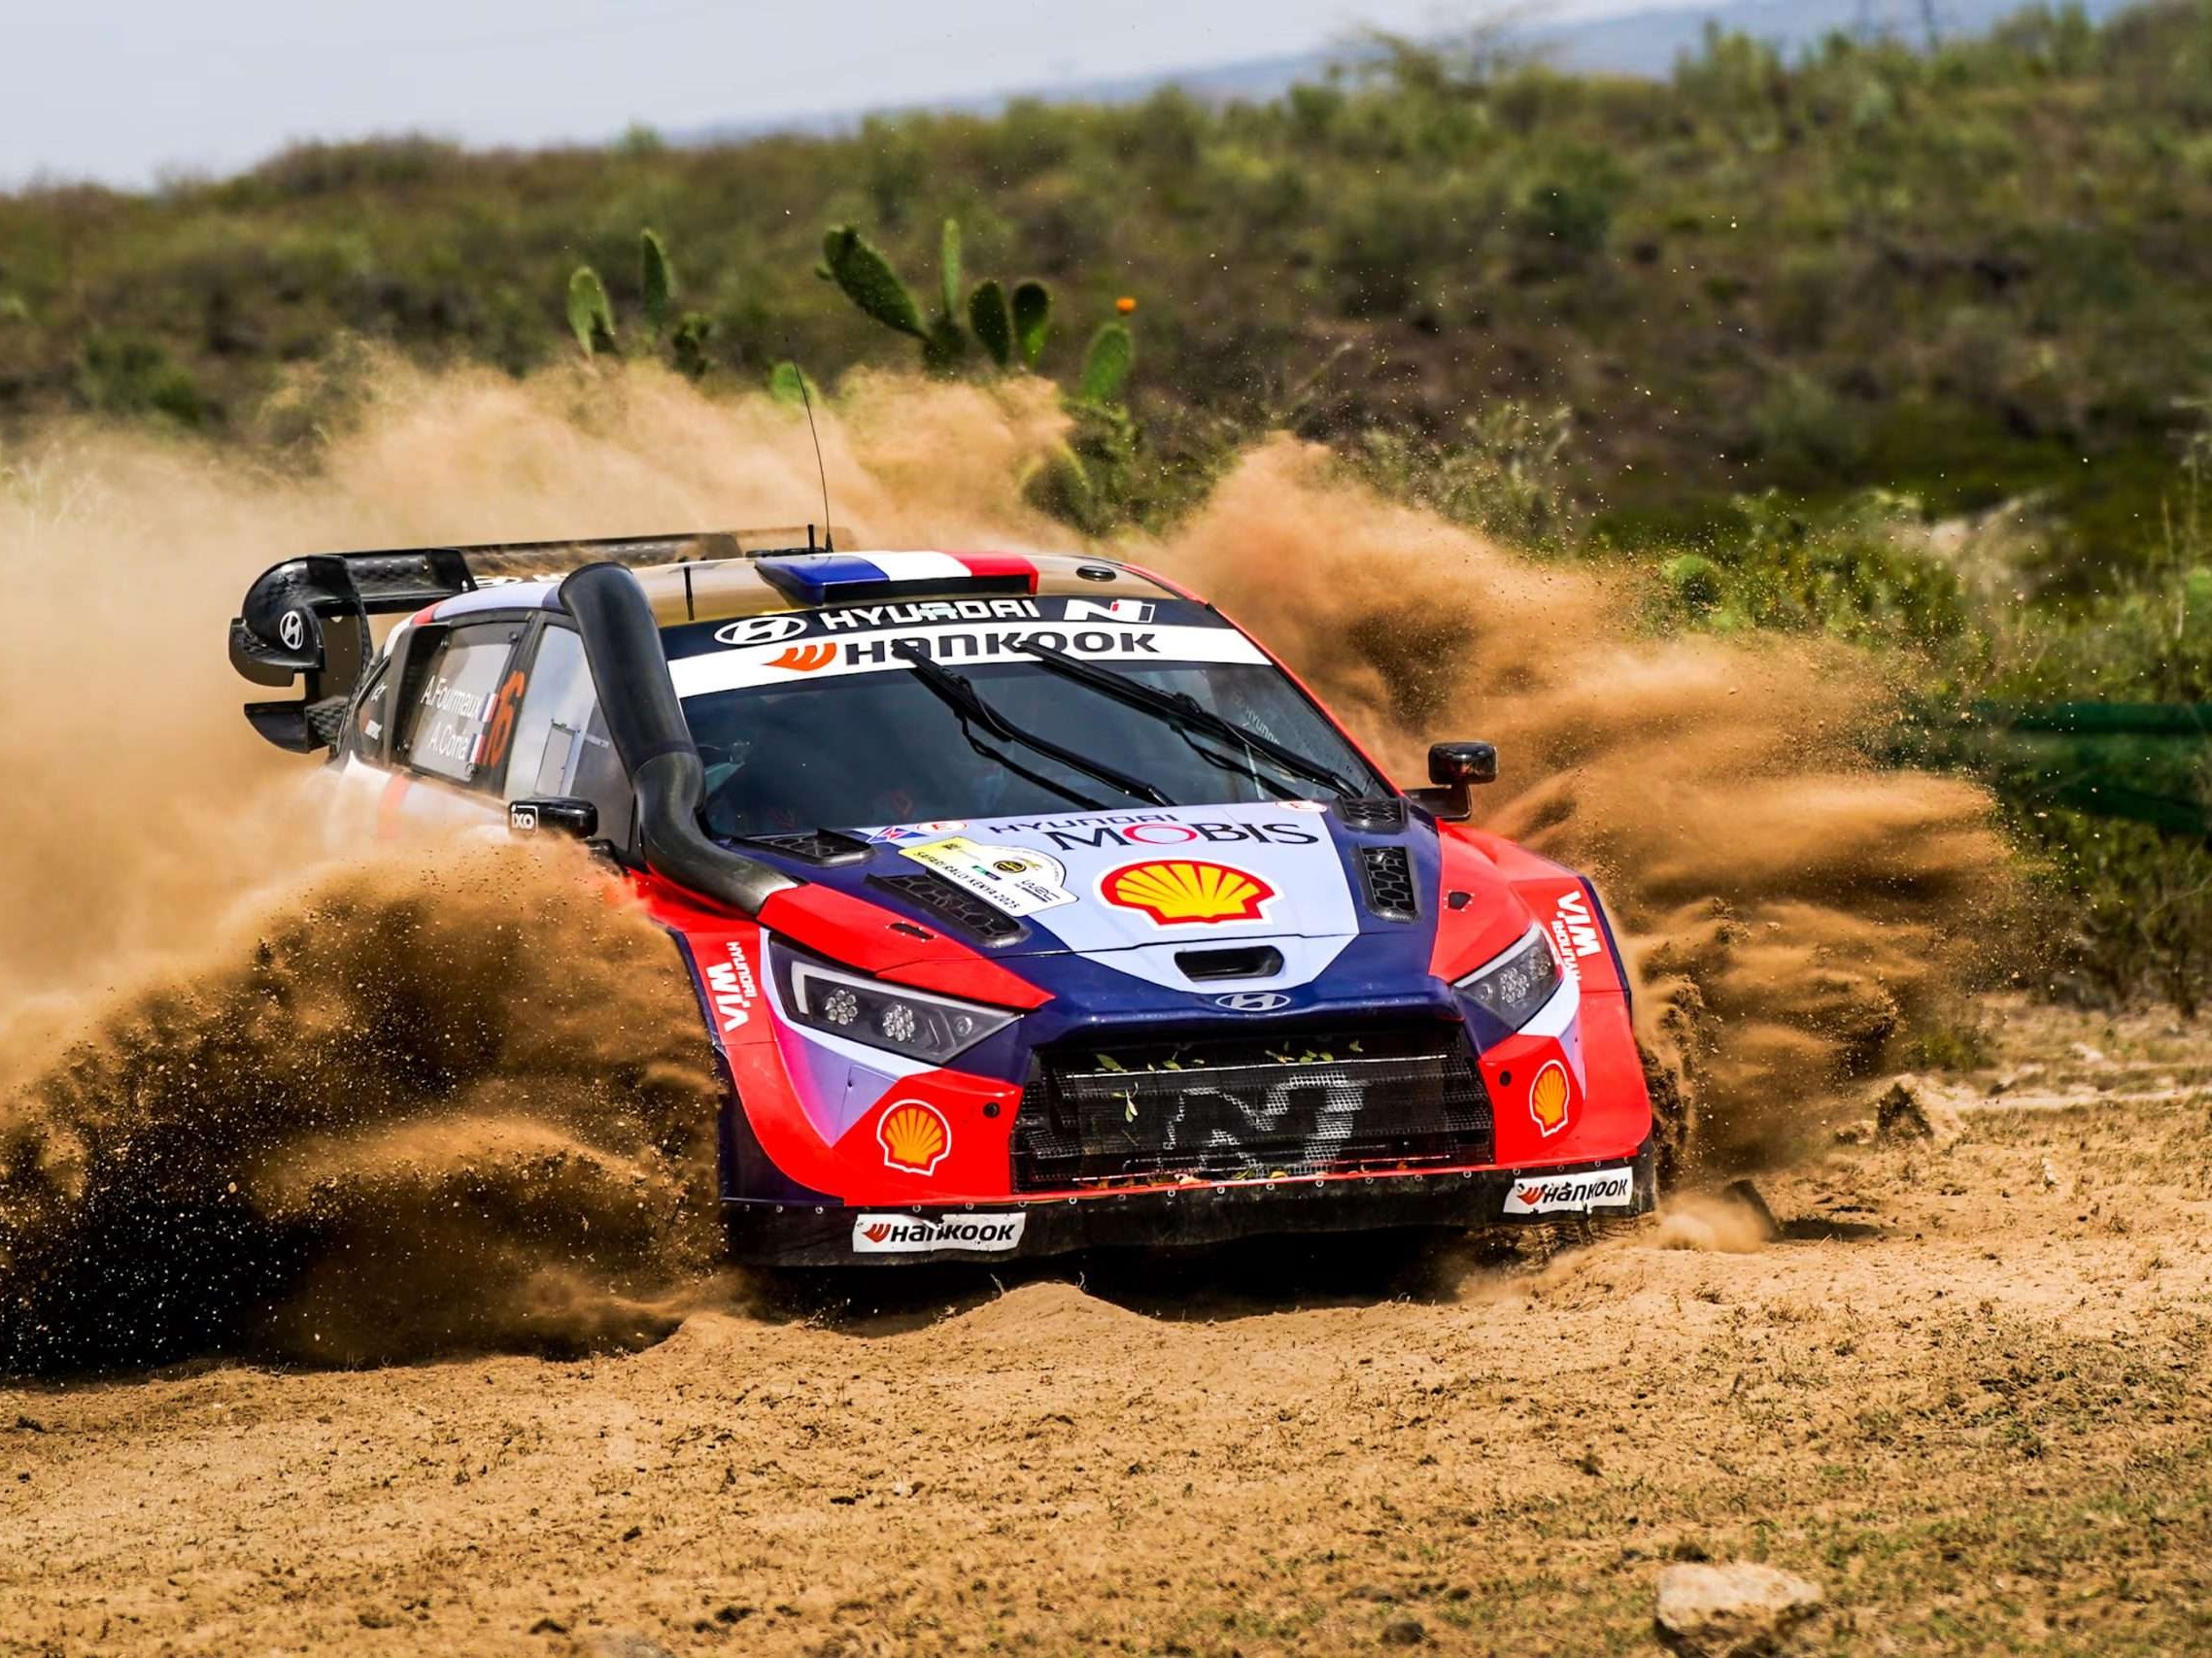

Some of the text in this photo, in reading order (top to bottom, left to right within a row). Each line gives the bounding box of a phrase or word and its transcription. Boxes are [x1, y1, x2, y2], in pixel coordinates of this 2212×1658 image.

[819, 599, 1041, 630] HYUNDAI
[989, 814, 1178, 833] HYUNDAI
[1041, 822, 1319, 851] MOBIS
[913, 851, 946, 866] SAFARI
[941, 864, 971, 879] RALLY
[965, 879, 999, 895] KENYA
[991, 894, 1023, 909] 2025
[726, 941, 758, 998] HYUNDAI
